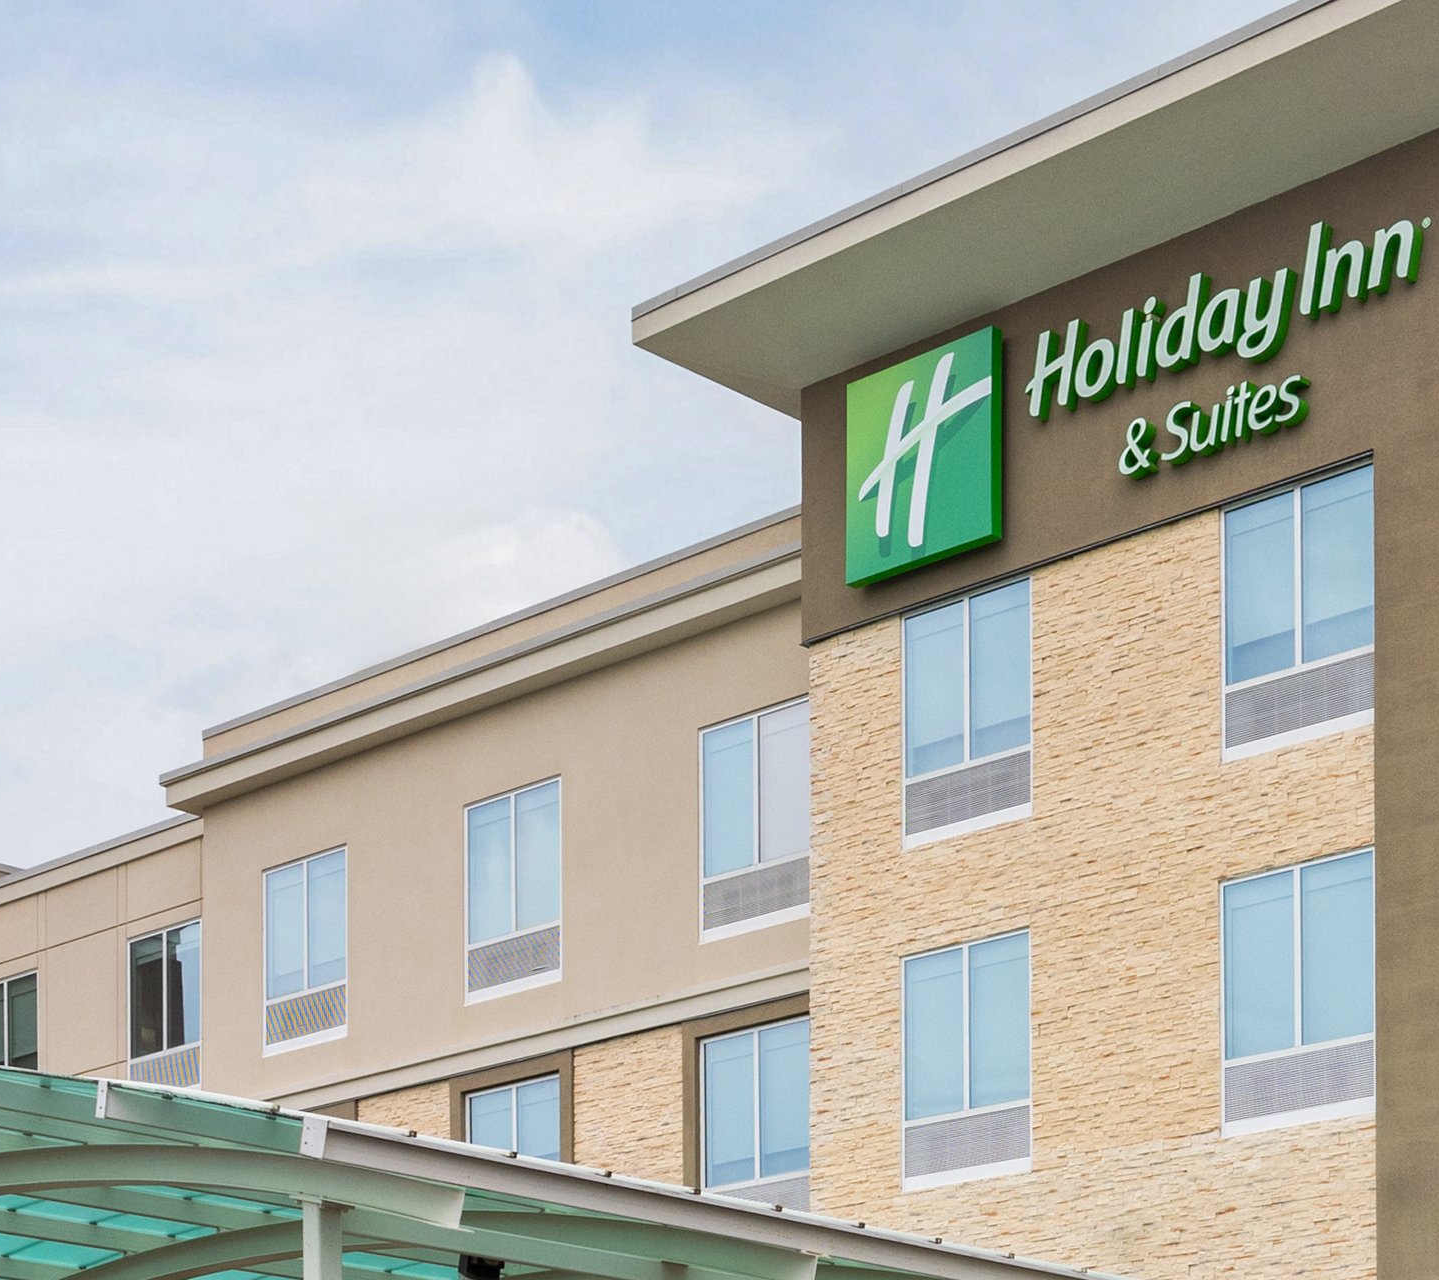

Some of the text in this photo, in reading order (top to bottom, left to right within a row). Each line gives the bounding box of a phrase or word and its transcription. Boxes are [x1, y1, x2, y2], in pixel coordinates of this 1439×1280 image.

[1025, 219, 1421, 420] Holiday Inn
[1118, 374, 1310, 478] & Suites
